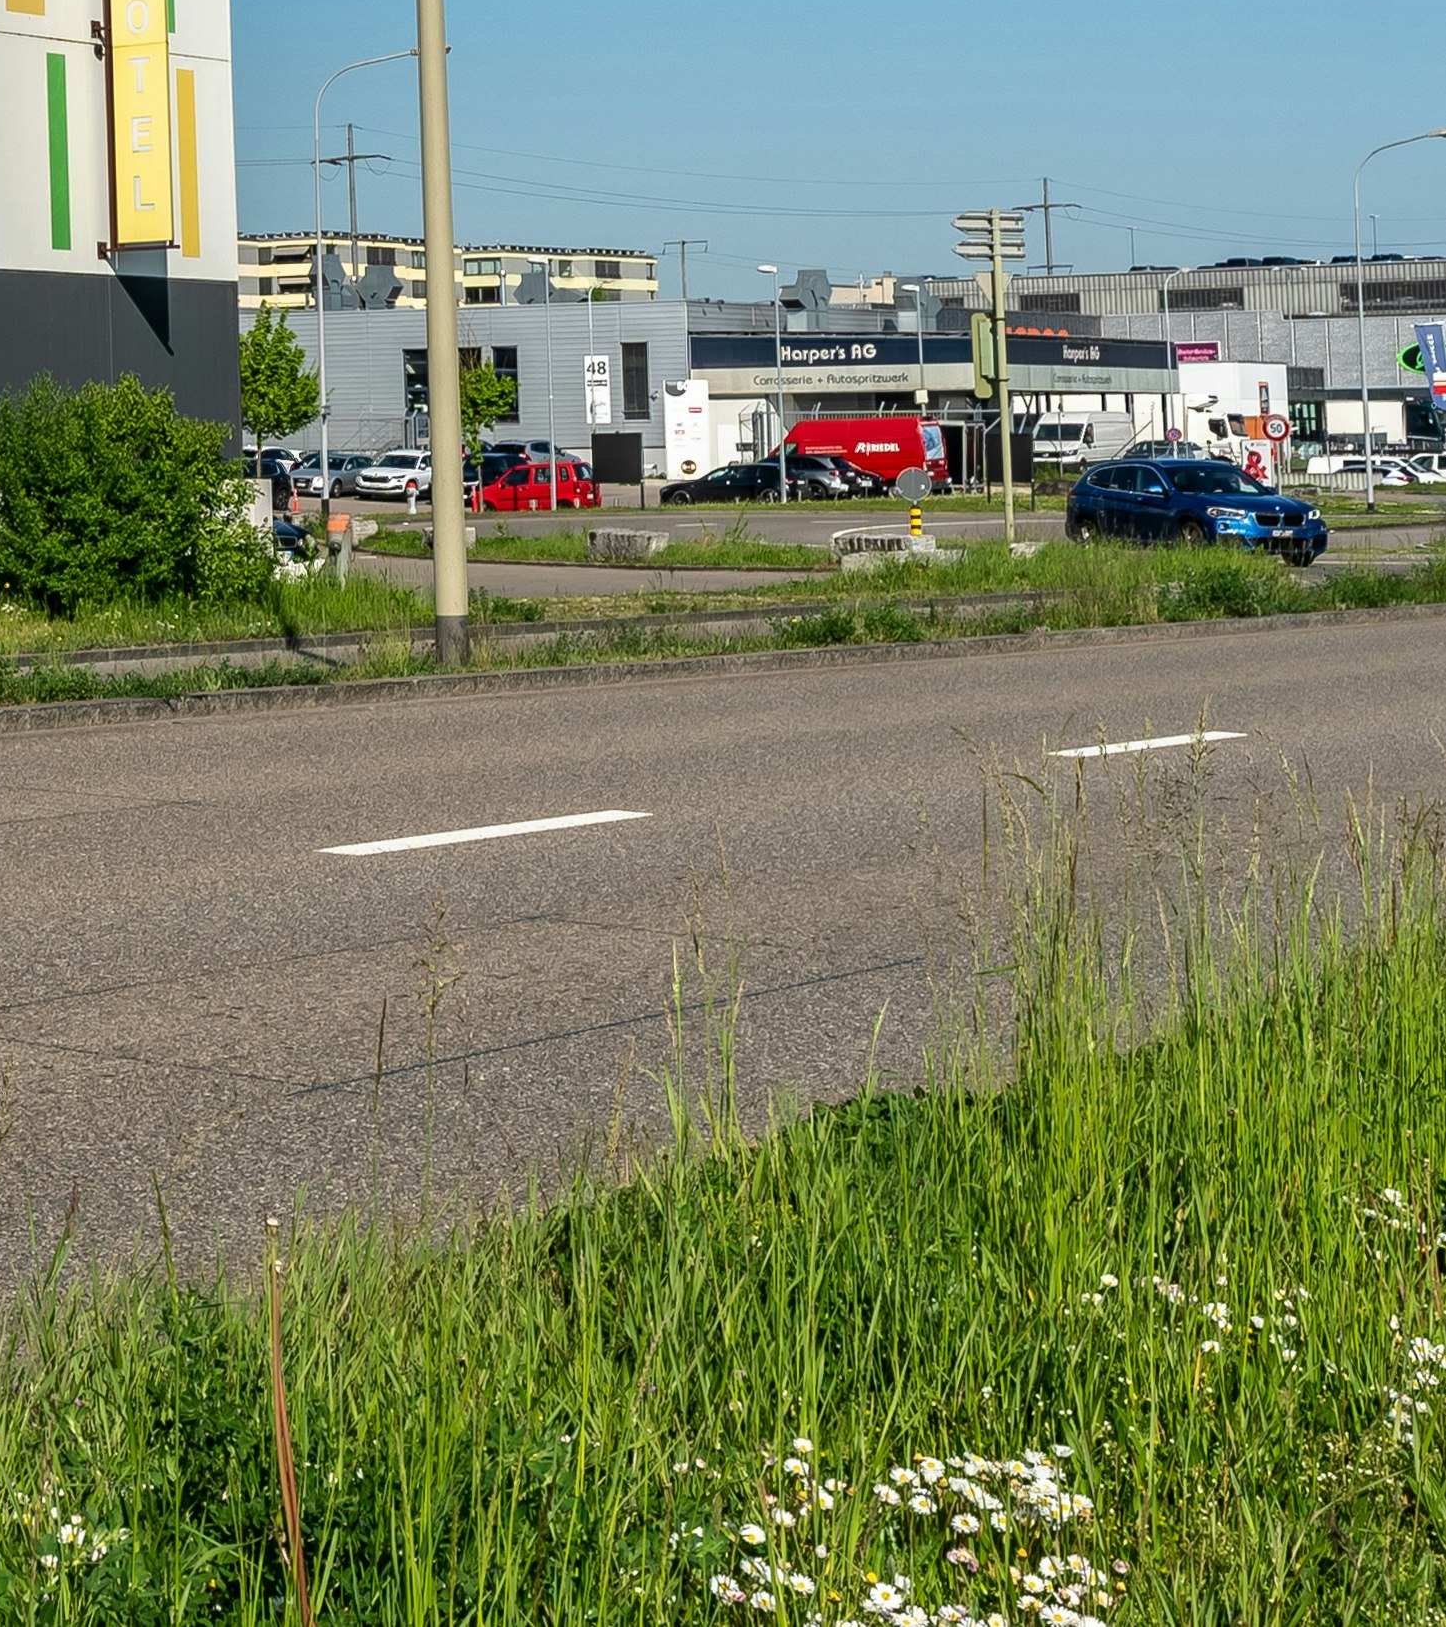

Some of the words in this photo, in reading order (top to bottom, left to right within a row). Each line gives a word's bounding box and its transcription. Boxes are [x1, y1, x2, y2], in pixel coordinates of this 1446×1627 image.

[780, 344, 847, 364] Harper's
[850, 343, 877, 359] AG
[586, 360, 607, 375] 48
[826, 372, 909, 386] Autospritzwerk
[1270, 423, 1283, 434] 50
